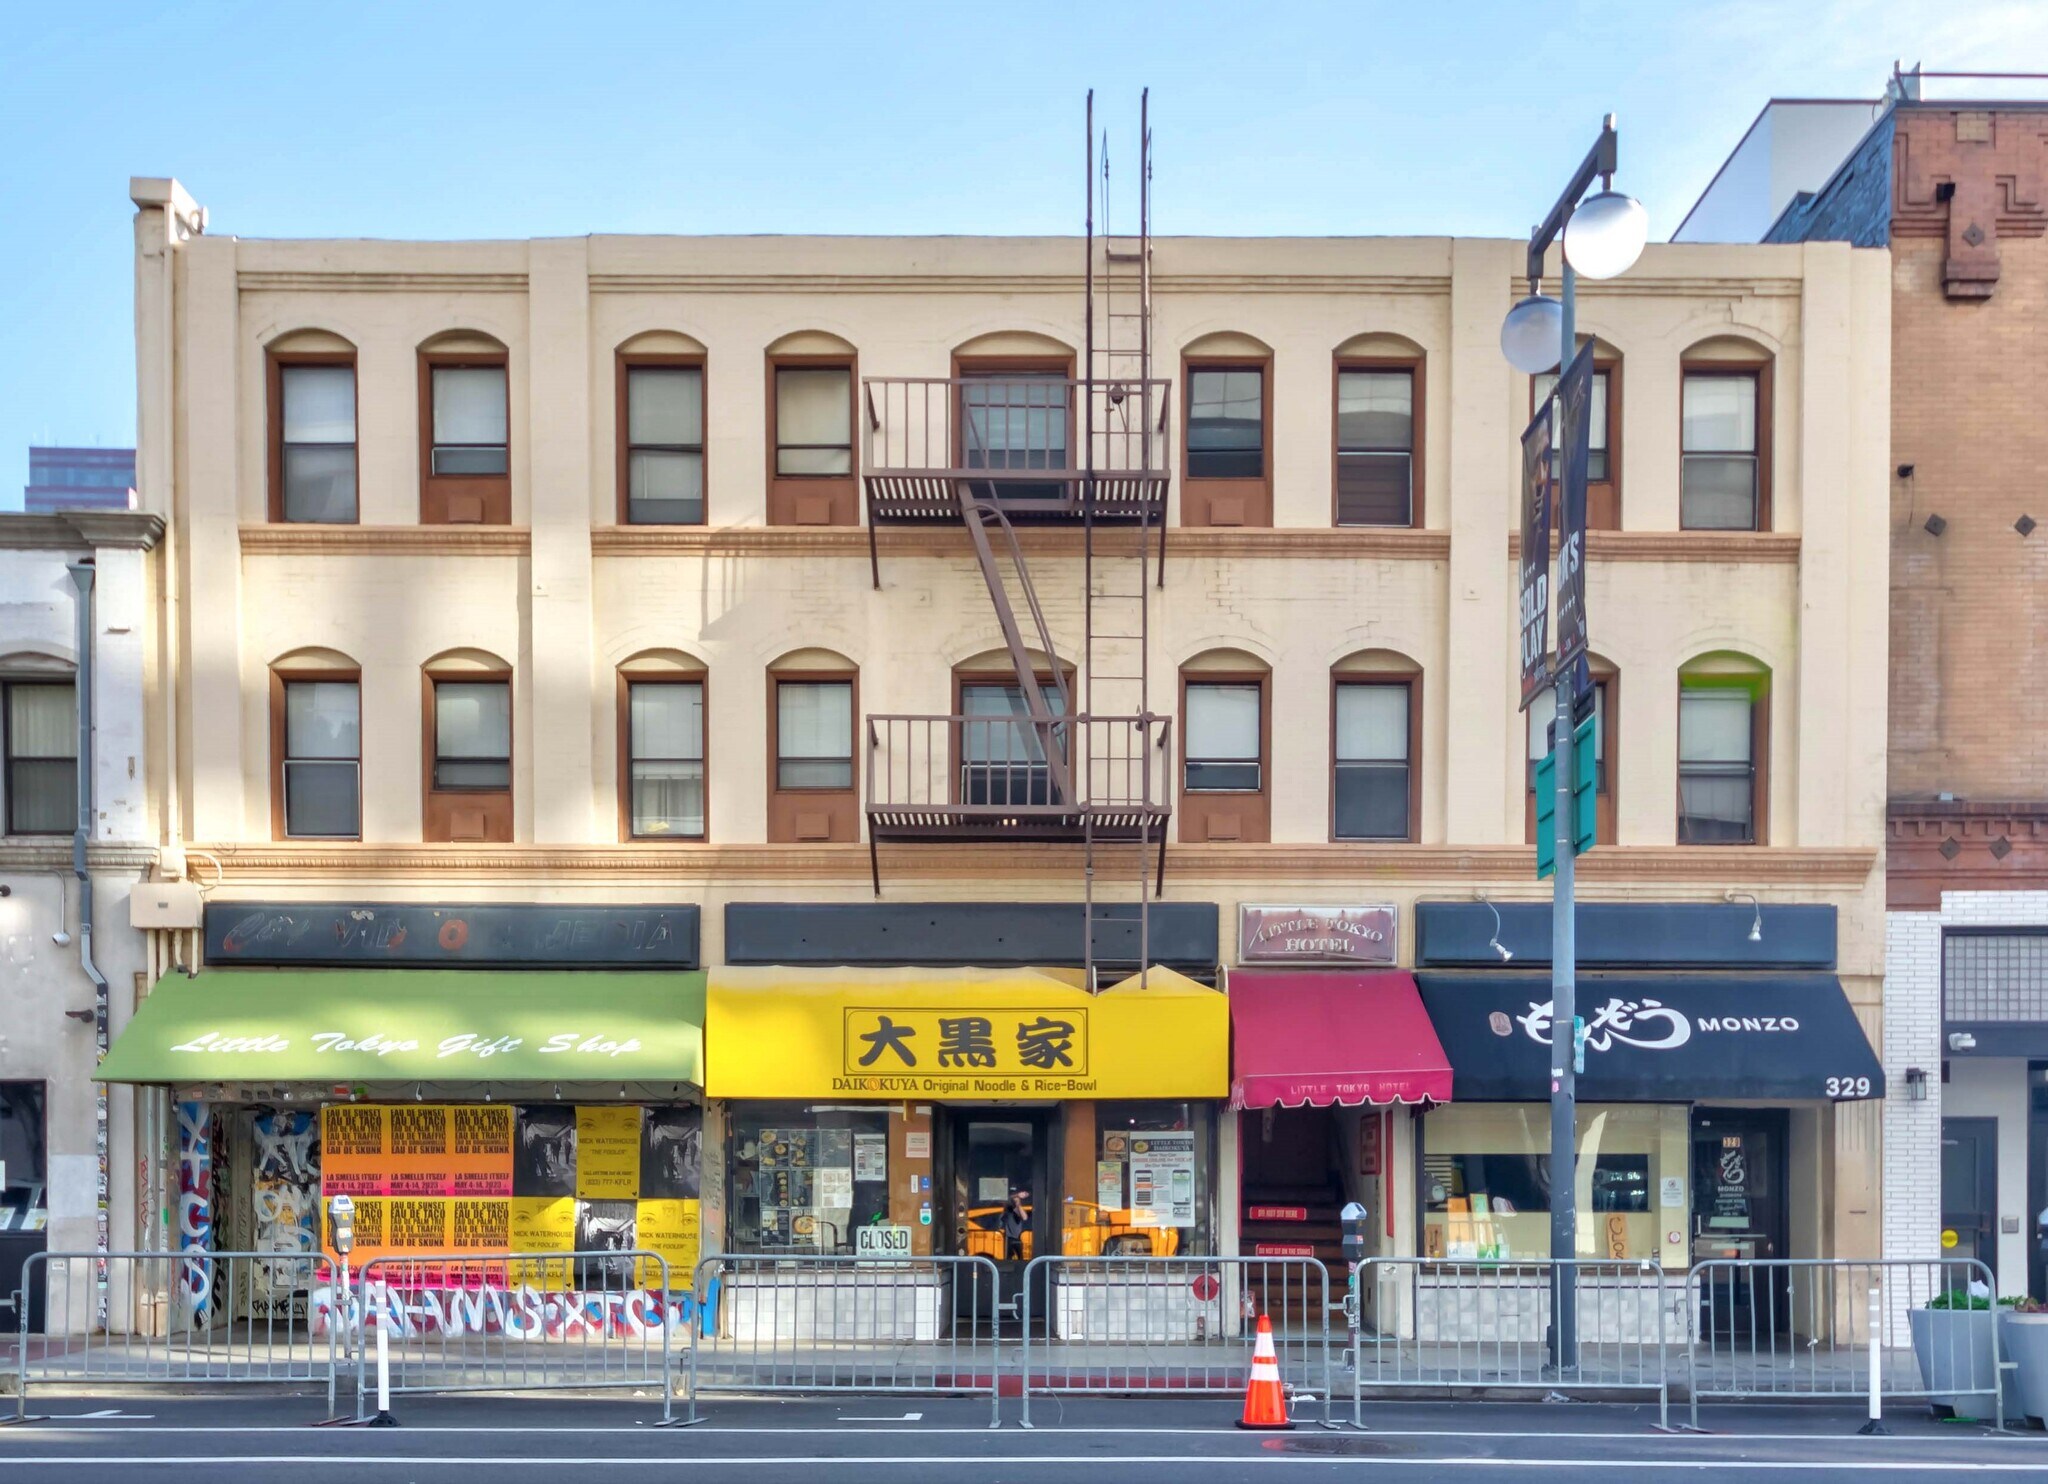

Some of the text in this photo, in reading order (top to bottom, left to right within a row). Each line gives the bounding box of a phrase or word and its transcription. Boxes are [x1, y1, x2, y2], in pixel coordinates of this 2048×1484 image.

[1258, 917, 1383, 943] LITTLE TOKYO
[1285, 938, 1355, 952] HOTEL
[1698, 1017, 1799, 1032] MONZO
[170, 1031, 642, 1058] Little Tokyo Gift Shop
[858, 1015, 1076, 1069] 大黒家
[832, 1077, 1097, 1094] DAIKOKUYA Original Noodle & Rice-Bowl
[1290, 1082, 1410, 1095] LITTLE TOKYO HOTEL
[1826, 1077, 1870, 1097] 329
[360, 1209, 382, 1218] TACO
[390, 1209, 445, 1218] EAU DE TACO
[454, 1209, 509, 1218] EAU DE TACO
[356, 1239, 382, 1247] SKUNK
[390, 1239, 444, 1247] EAU DE SKUNK
[454, 1239, 508, 1247] EAU DE SKUNK
[861, 1231, 908, 1249] CLOSED
